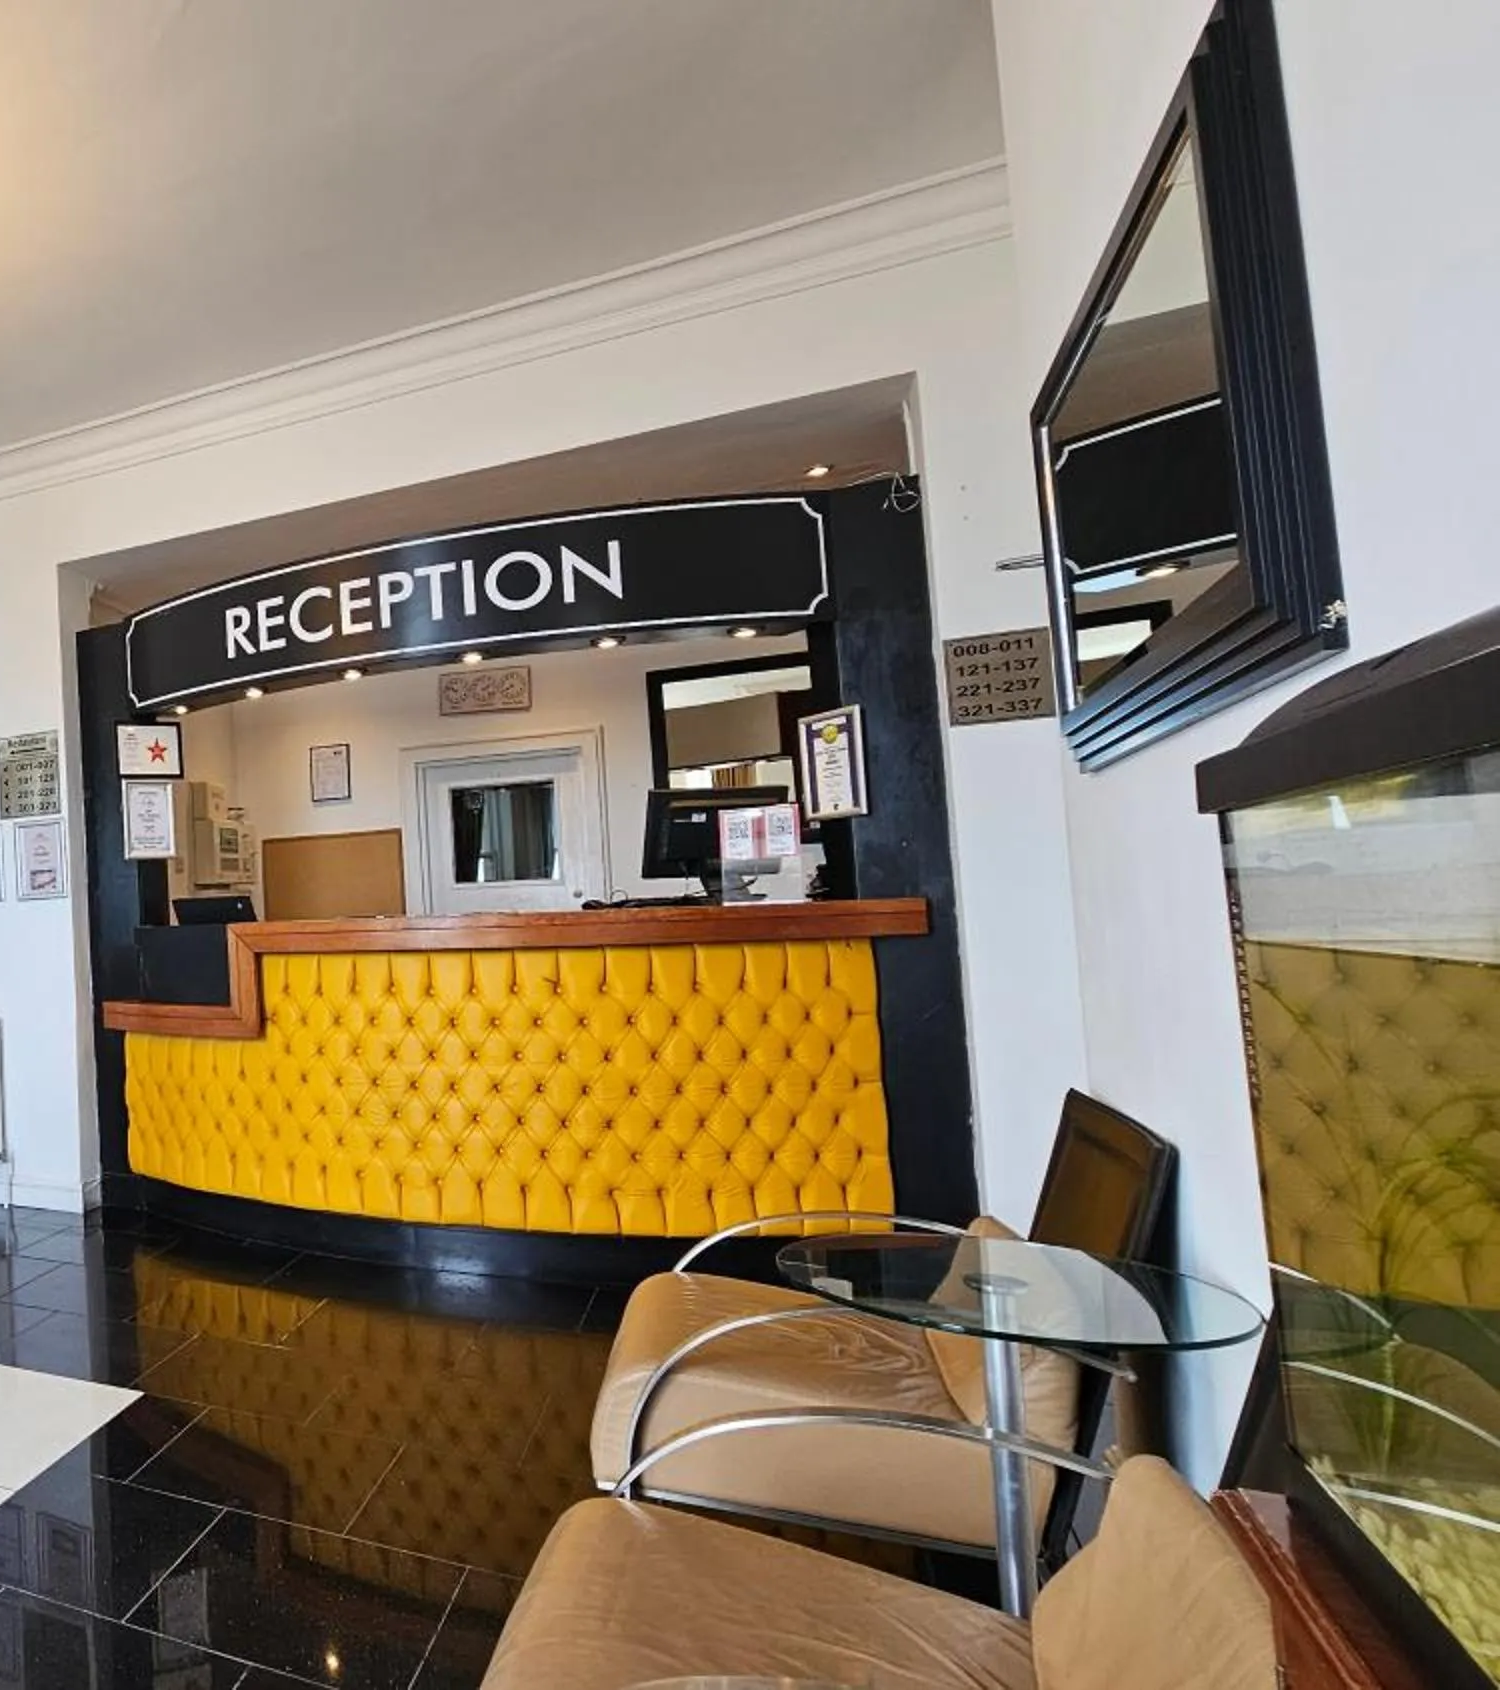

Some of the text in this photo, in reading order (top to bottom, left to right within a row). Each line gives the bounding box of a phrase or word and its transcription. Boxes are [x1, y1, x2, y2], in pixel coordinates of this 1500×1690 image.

[225, 540, 623, 658] RECEPTION
[953, 637, 1033, 657] 008-011
[956, 657, 1038, 677] 121-137
[956, 678, 1040, 697] 221-237
[958, 698, 1043, 717] 321-337
